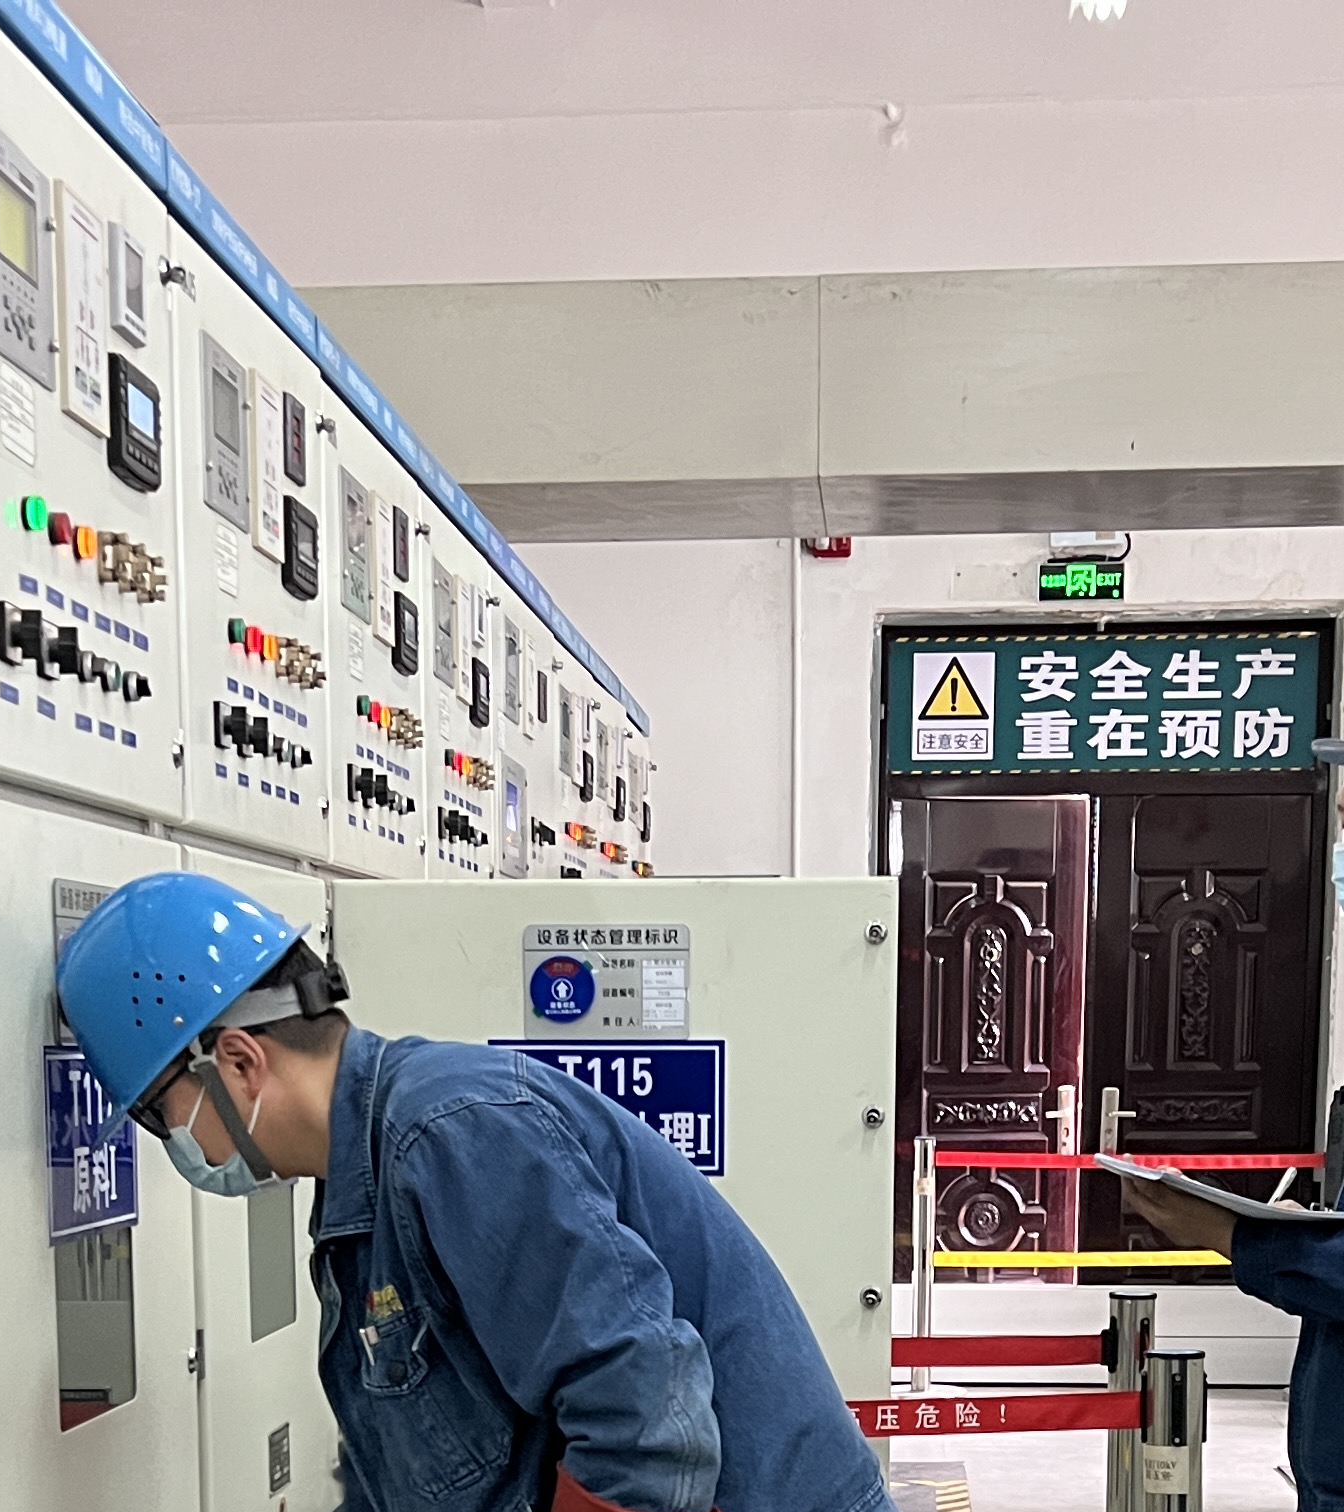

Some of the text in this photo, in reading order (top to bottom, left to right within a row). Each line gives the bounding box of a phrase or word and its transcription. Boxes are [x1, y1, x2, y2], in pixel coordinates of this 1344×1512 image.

[1096, 573, 1122, 586] EXIT
[1017, 648, 1296, 703] 安全生产
[922, 733, 984, 750] 注意安全
[1015, 707, 1295, 760] 重在预防
[537, 929, 679, 945] 设备状态管理标识
[558, 1055, 653, 1097] T115
[69, 1070, 113, 1127] T11
